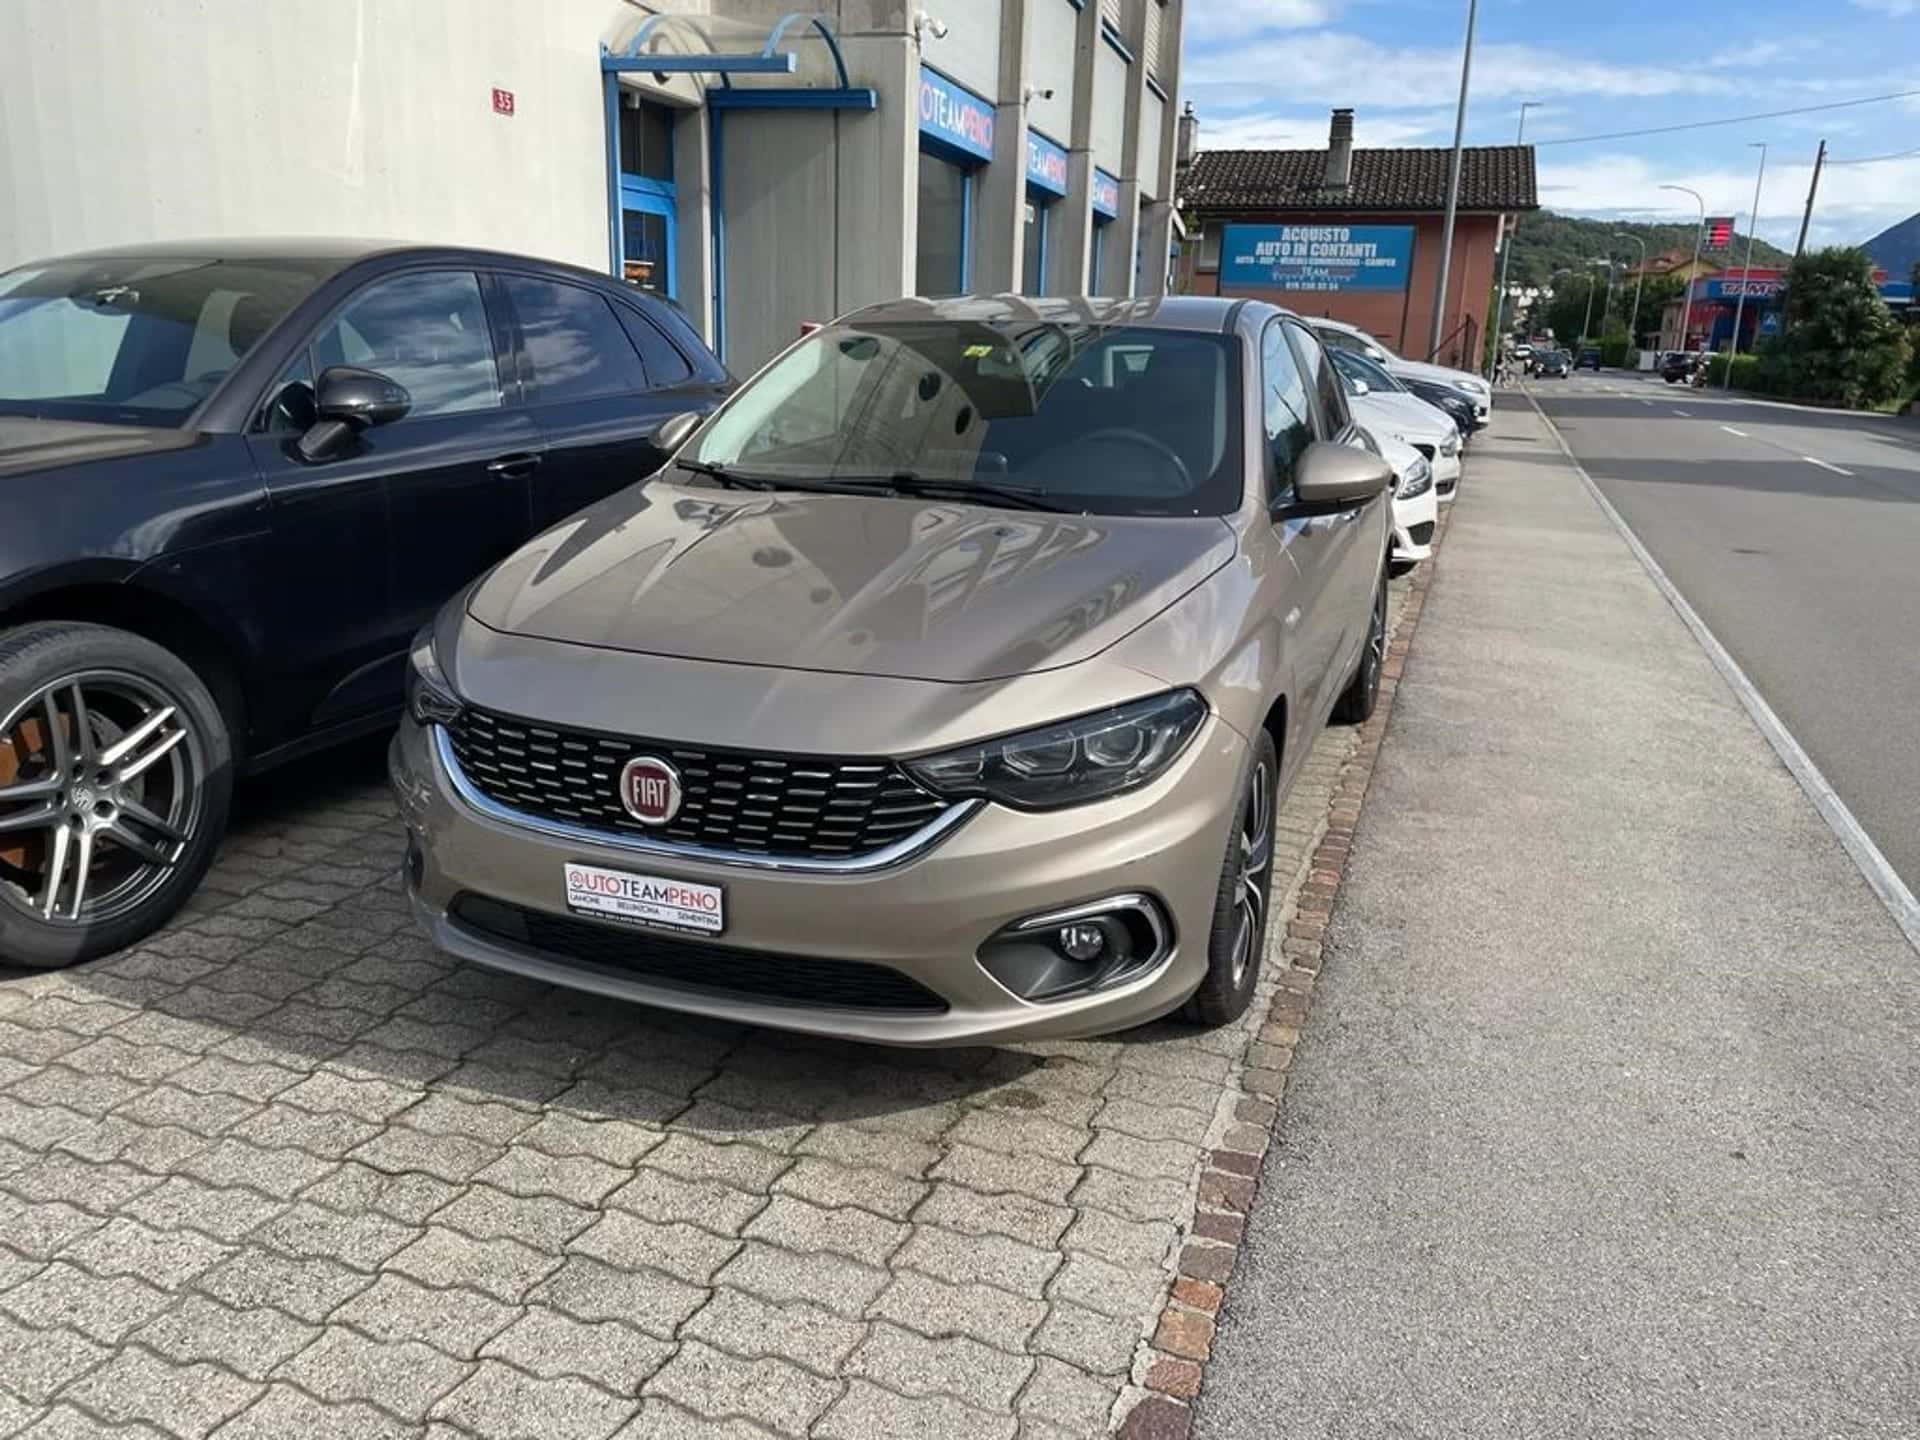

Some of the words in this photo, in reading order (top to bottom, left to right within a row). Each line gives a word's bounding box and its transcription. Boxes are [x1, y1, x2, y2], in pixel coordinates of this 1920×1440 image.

[496, 90, 511, 110] 35
[1281, 227, 1350, 242] ACQUISTO
[1255, 241, 1291, 256] AUTO
[1293, 242, 1308, 257] IN
[1310, 242, 1377, 258] CONTANTI
[632, 775, 667, 808] FIAT
